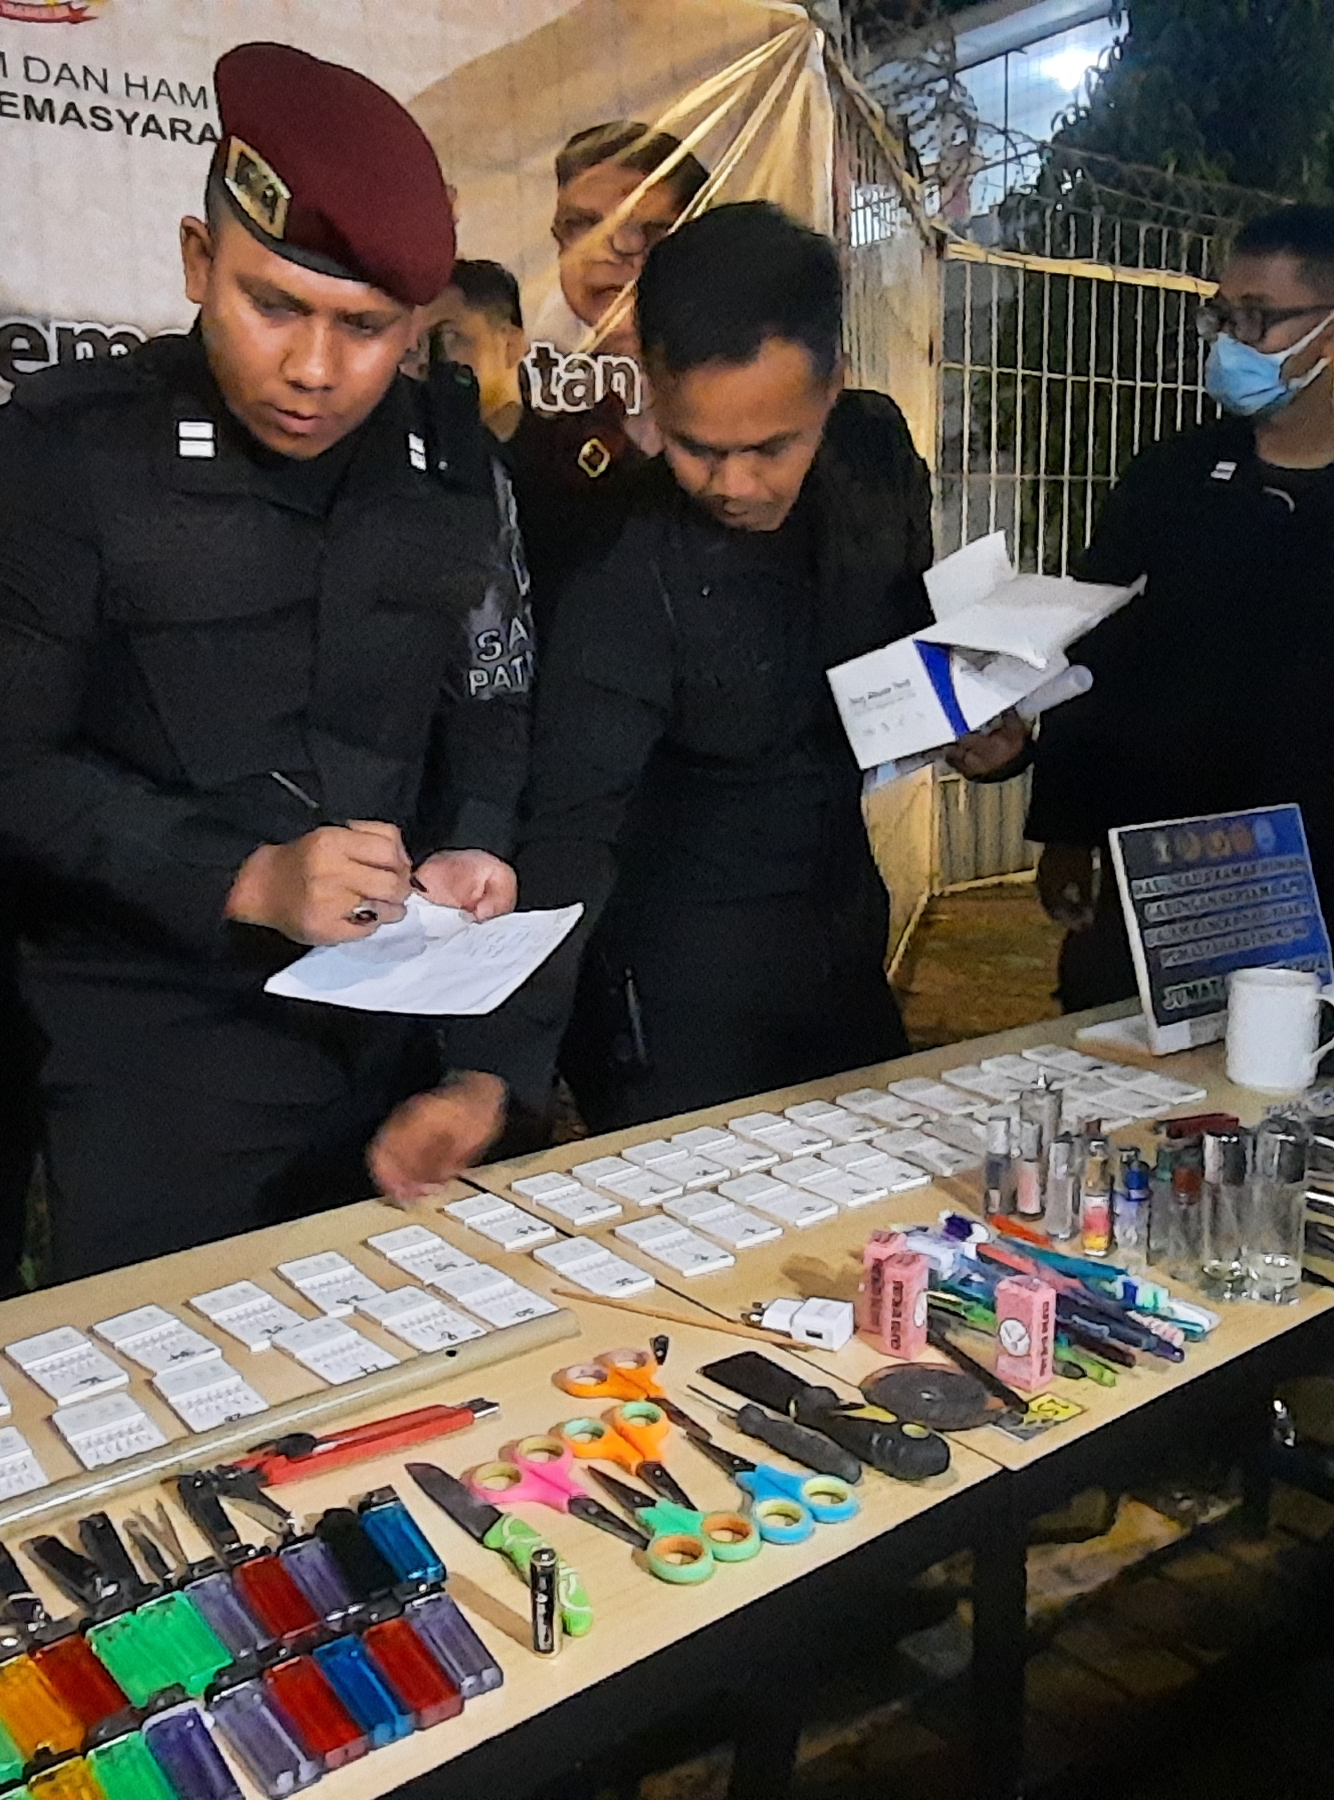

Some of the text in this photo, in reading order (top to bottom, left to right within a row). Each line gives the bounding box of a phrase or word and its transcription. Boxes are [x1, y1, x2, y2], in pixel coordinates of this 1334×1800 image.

[24, 55, 109, 94] DAN
[125, 72, 209, 110] HAM
[468, 653, 533, 697] PAT
